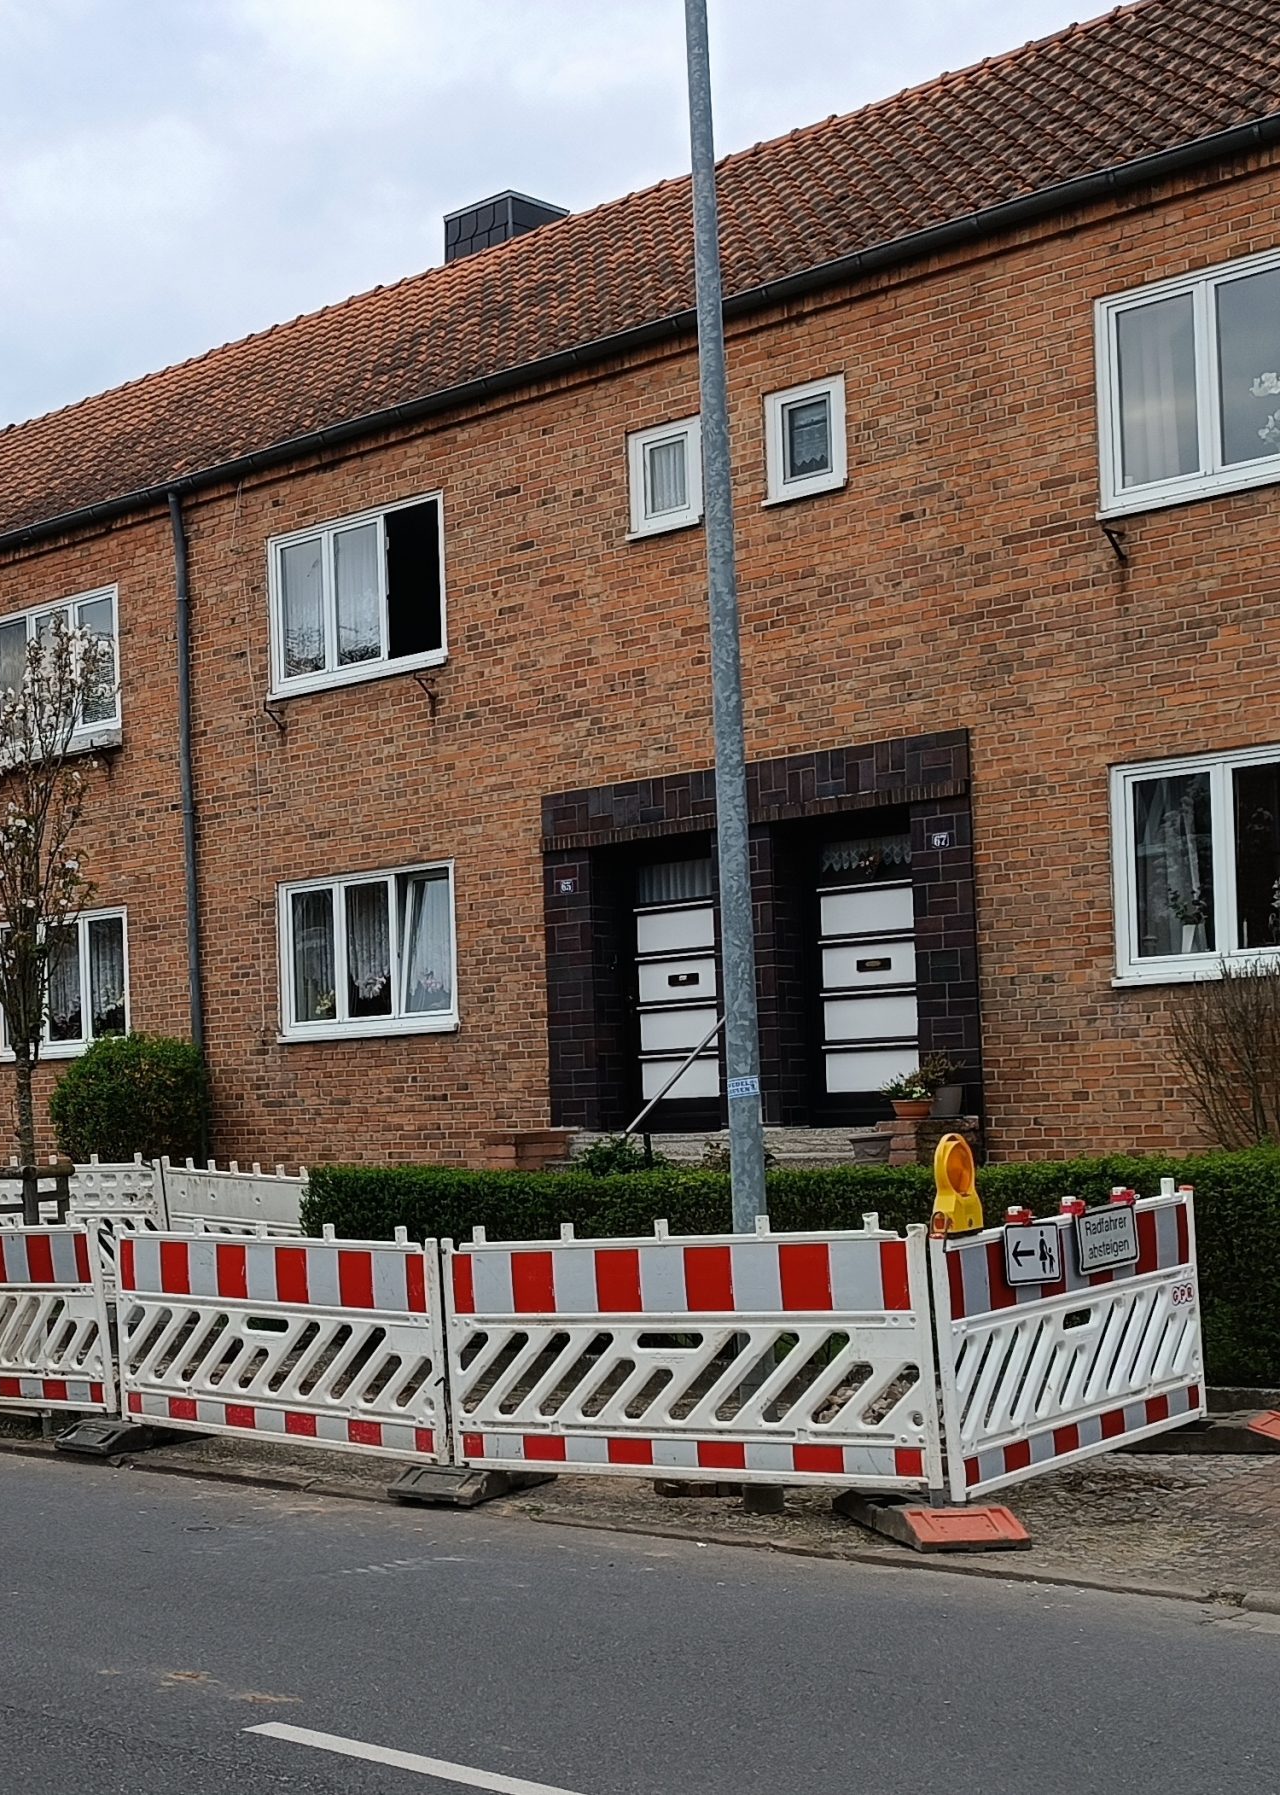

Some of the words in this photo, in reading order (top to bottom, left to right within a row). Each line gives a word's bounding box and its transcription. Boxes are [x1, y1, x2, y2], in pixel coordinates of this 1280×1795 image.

[933, 834, 947, 847] 67
[1085, 1215, 1127, 1237] Radfahrer
[1088, 1239, 1130, 1260] absteigen
[1172, 1285, 1193, 1304] GPR
